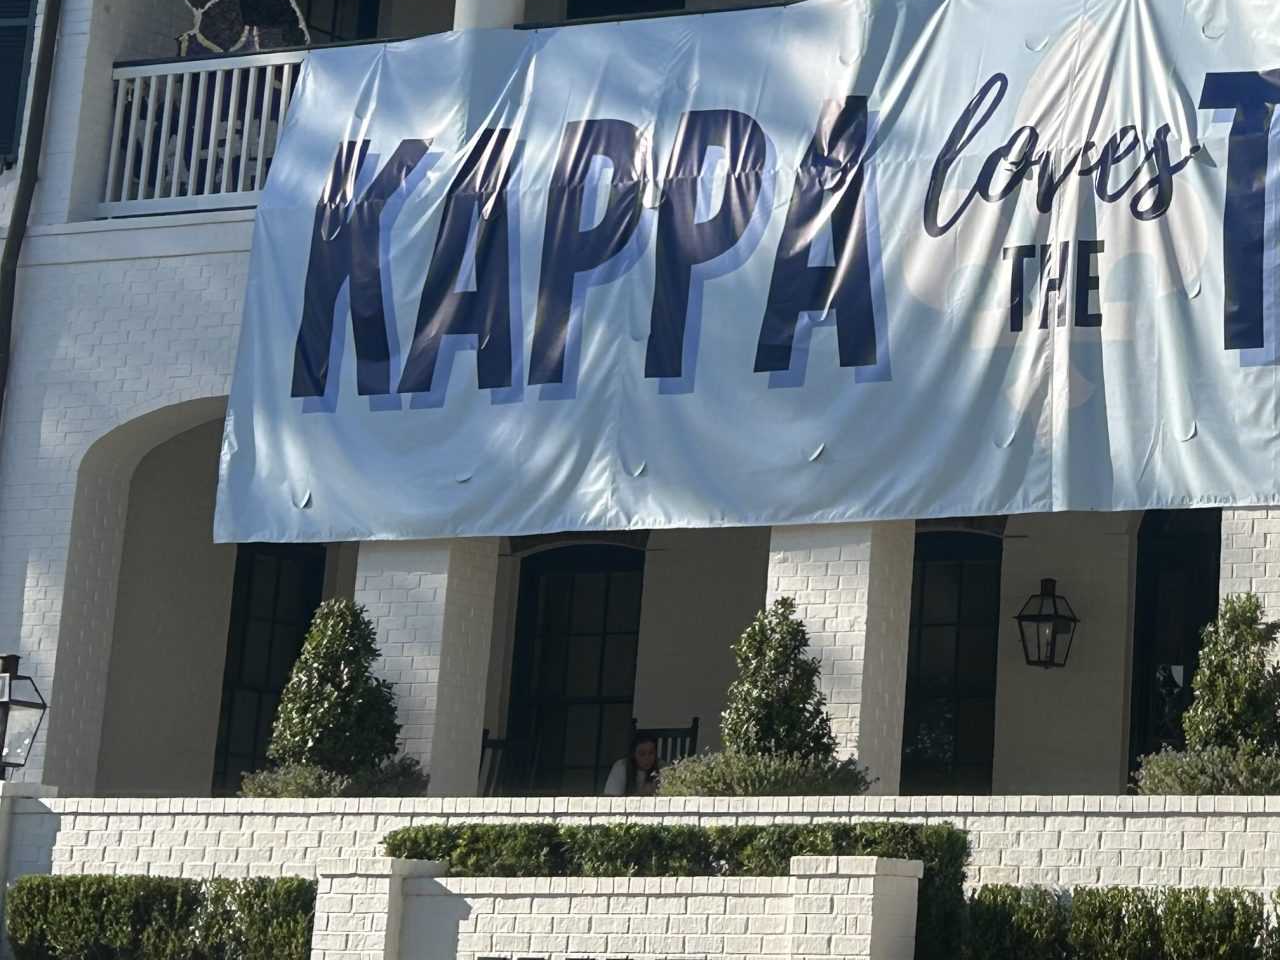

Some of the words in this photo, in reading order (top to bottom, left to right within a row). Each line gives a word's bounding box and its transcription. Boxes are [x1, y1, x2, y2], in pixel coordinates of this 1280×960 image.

[924, 72, 1200, 238] loves
[291, 95, 877, 398] KAPPA
[1002, 240, 1105, 332] THE
